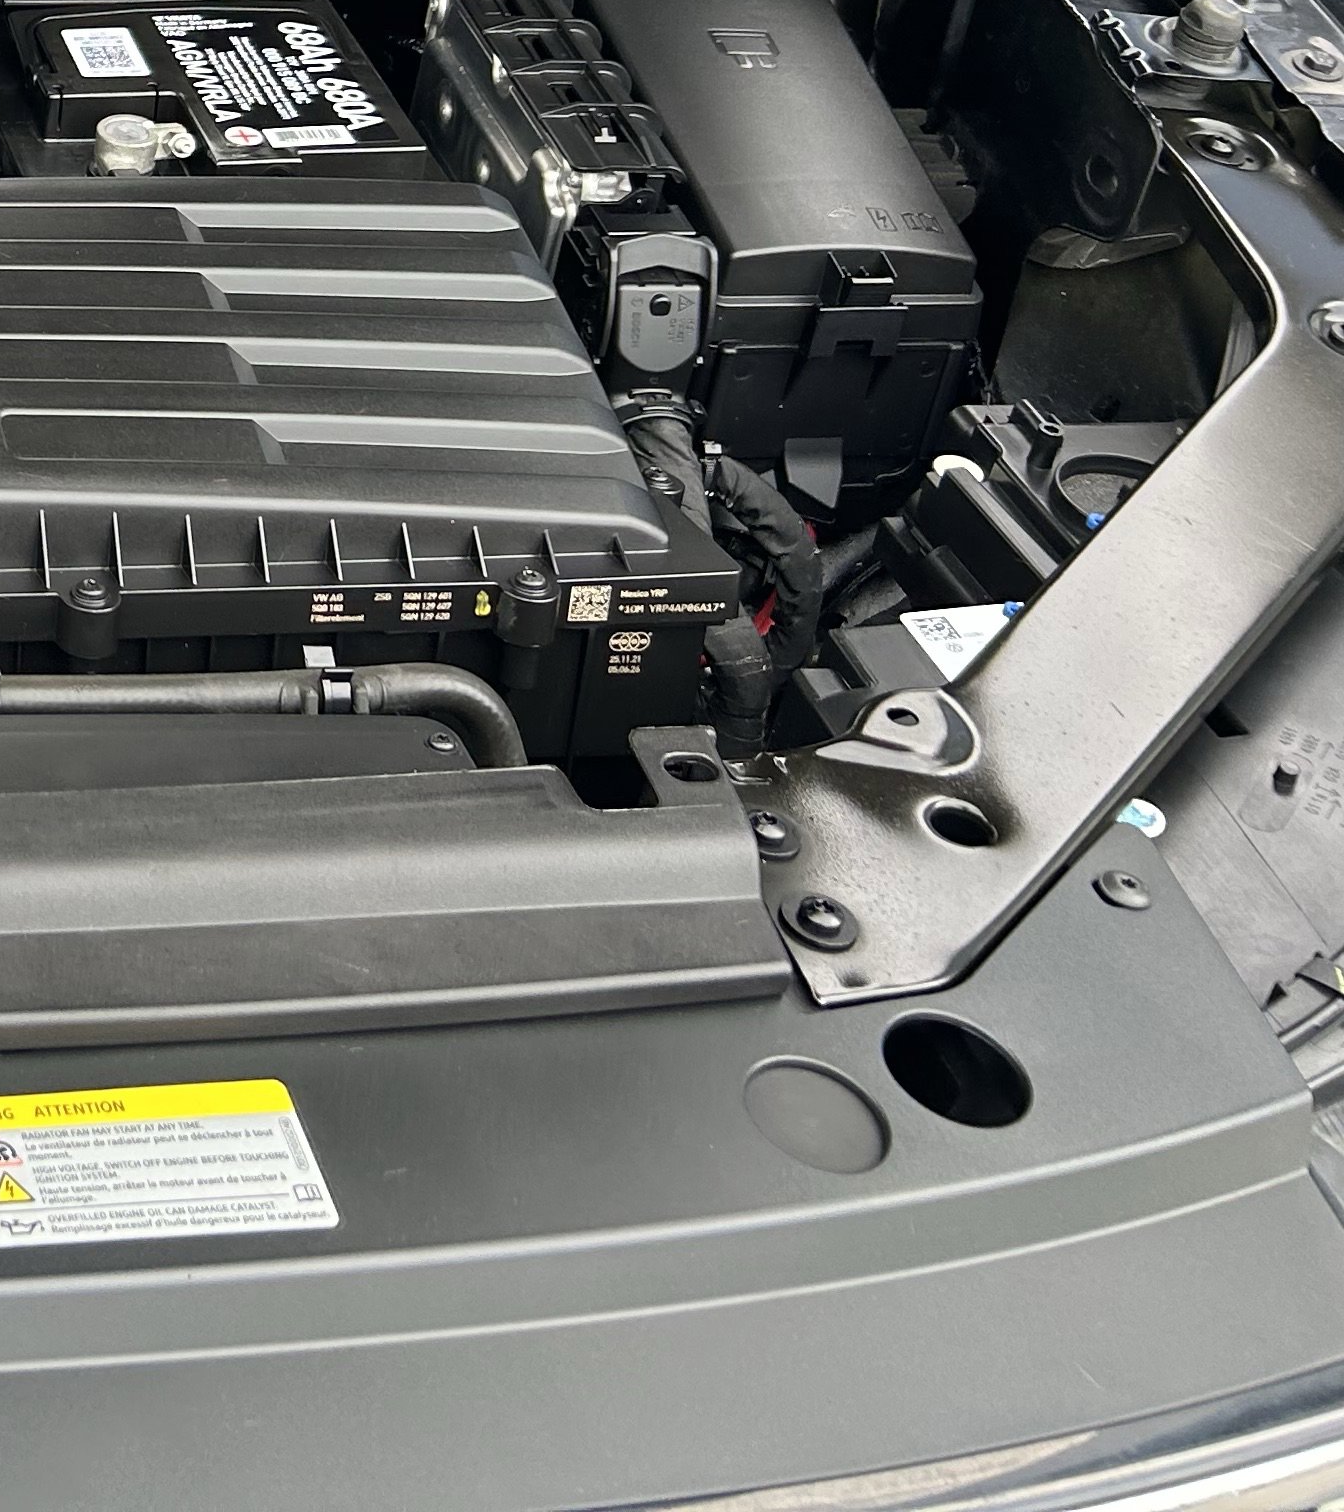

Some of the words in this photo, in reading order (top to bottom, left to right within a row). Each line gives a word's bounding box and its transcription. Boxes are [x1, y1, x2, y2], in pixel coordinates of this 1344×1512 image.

[165, 39, 242, 123] AGM/VRLA
[277, 21, 344, 74] 68Ah
[316, 77, 387, 130] 680A
[423, 592, 438, 600] 129
[649, 589, 668, 598] YRP
[34, 1100, 126, 1118] ATTENTION
[21, 1128, 70, 1140] RADIATOR
[70, 1127, 91, 1137] FAN
[92, 1126, 114, 1135] MAY
[114, 1124, 143, 1134] START
[144, 1123, 156, 1133] AT
[157, 1122, 177, 1132] ANY
[39, 1138, 91, 1150] ventilateur
[93, 1138, 107, 1148] de
[109, 1135, 152, 1146] radiateur
[33, 1165, 57, 1175] HIGH
[103, 1159, 142, 1170] SWITCH
[143, 1158, 162, 1168] OFF
[163, 1157, 199, 1167] ENGINE
[201, 1155, 238, 1165] BEFORE
[240, 1151, 290, 1162] TOUCHING
[35, 1174, 78, 1184] IGNITION
[159, 1178, 195, 1188] moteur
[48, 1210, 108, 1223] OVERFILLED
[109, 1207, 146, 1219] ENGINE
[146, 1207, 163, 1217] OIL
[165, 1206, 186, 1216] CAN
[187, 1203, 229, 1214] DAMAGE
[51, 1220, 113, 1235] Remplissage
[189, 1214, 242, 1227] dangereux
